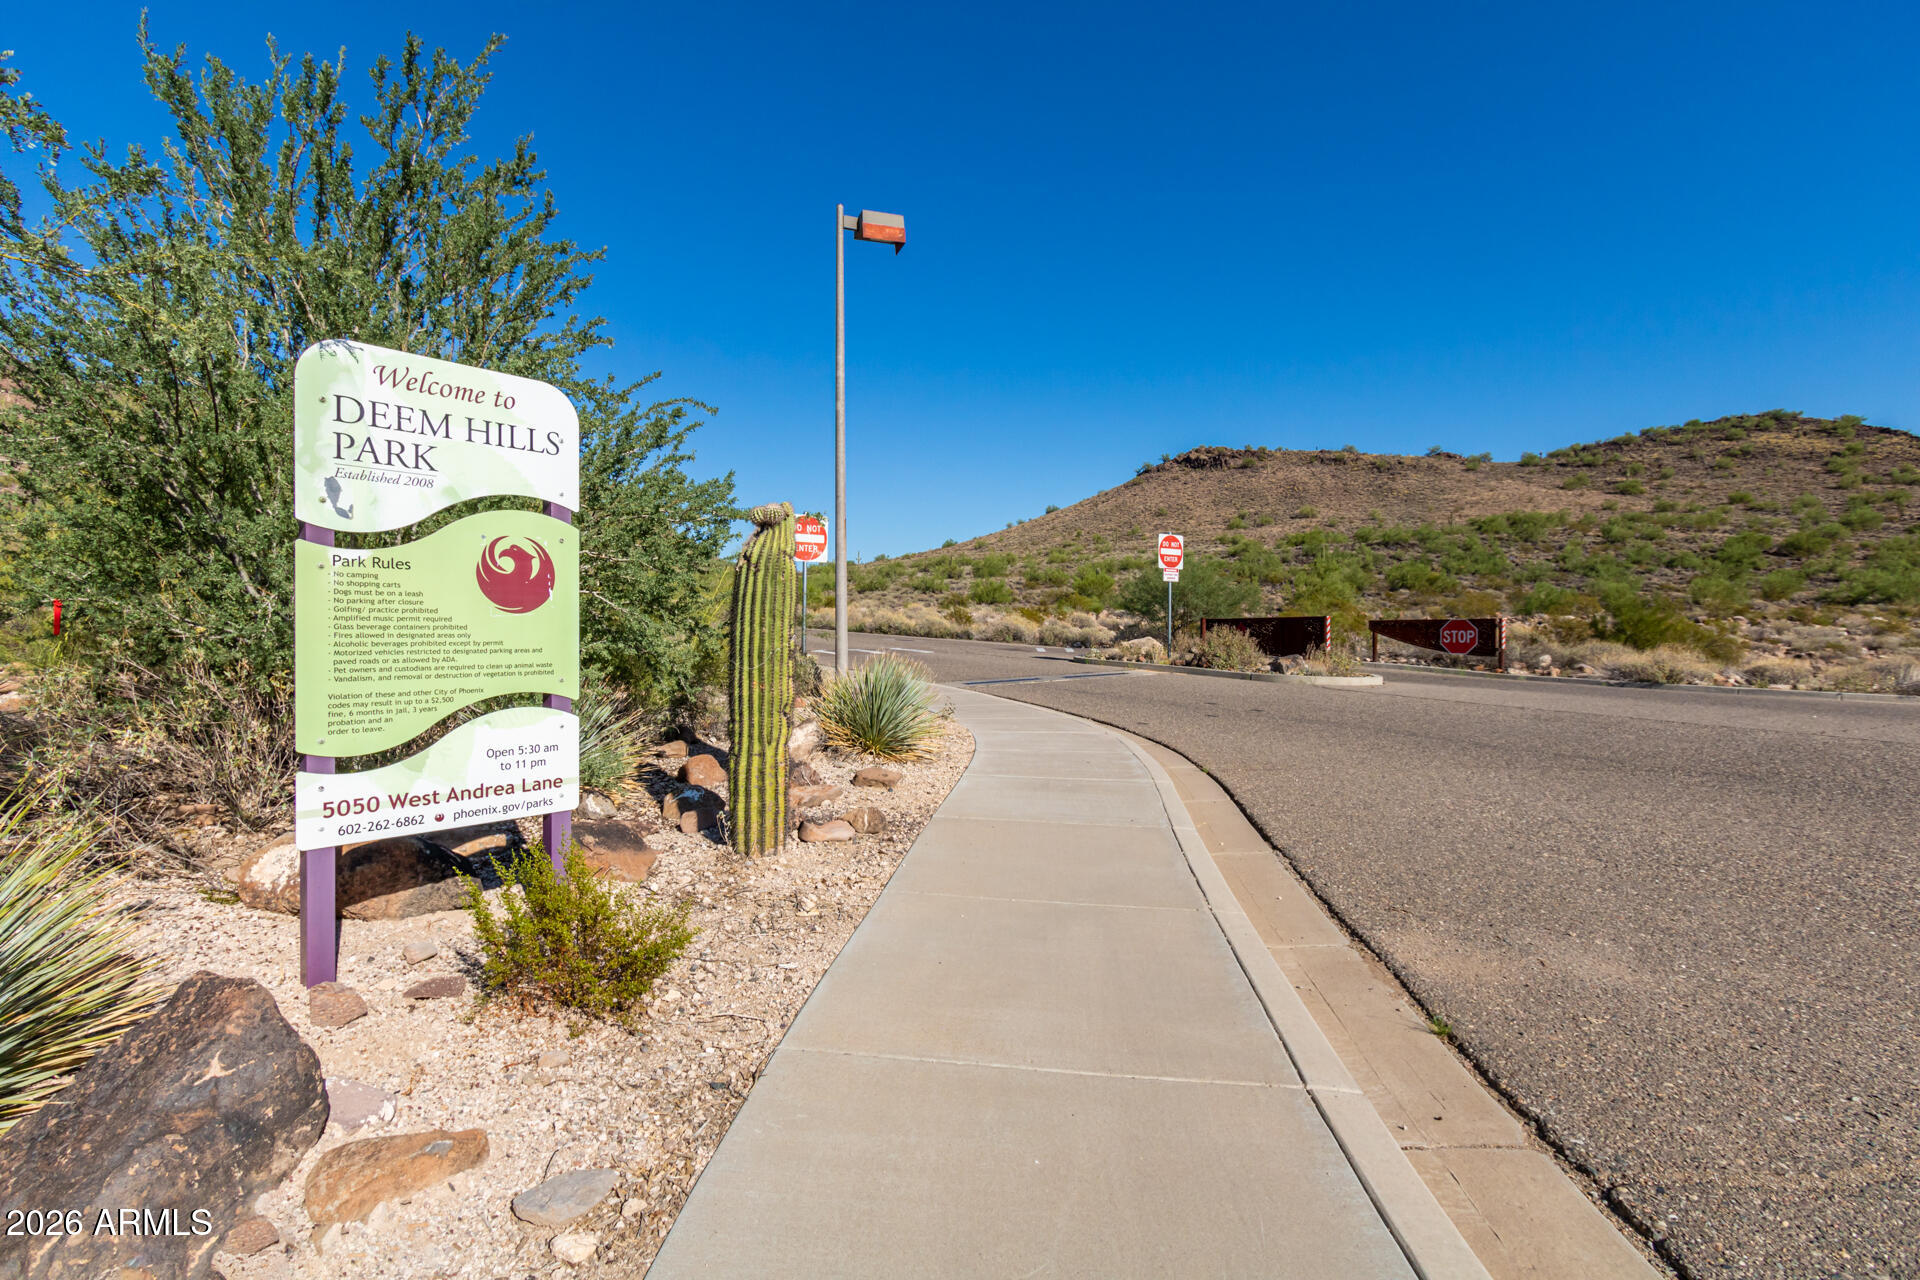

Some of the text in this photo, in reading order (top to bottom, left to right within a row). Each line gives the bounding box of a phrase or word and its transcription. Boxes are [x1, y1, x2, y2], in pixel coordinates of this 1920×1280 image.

[373, 365, 516, 410] Welcome to
[333, 394, 560, 455] DEEM HILLS
[333, 432, 439, 471] PARK
[334, 467, 434, 488] Established 2008
[332, 555, 411, 570] Park Rules
[334, 589, 352, 597] Dogs
[347, 580, 380, 588] shopping
[1443, 630, 1474, 643] STOP
[486, 744, 559, 760] Open 5:30 am
[500, 758, 546, 771] to 11 pm
[322, 777, 564, 819] 5050 West Andrea Lane
[338, 797, 553, 836] 602-262-6862 phoenix.gov/parks
